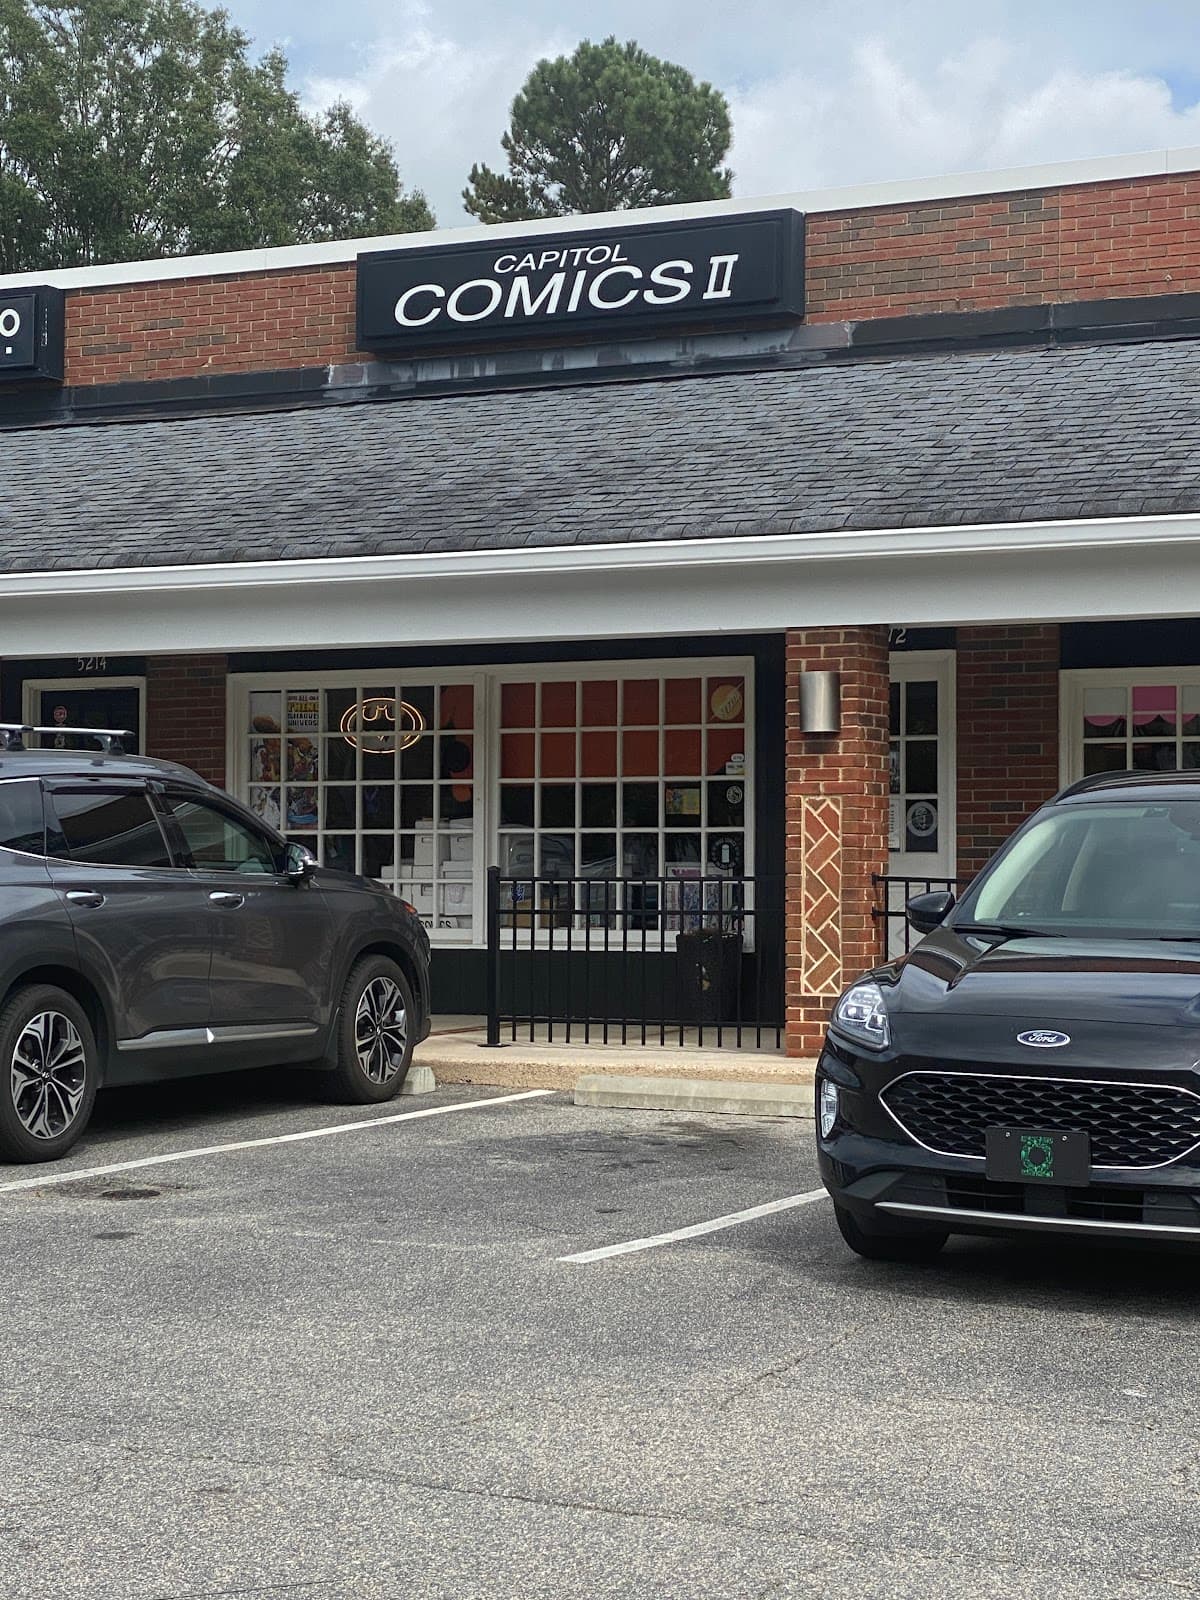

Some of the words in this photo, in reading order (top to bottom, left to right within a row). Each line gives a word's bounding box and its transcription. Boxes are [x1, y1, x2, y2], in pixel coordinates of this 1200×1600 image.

[494, 243, 628, 273] CAPITOL
[394, 259, 694, 327] COMICS
[702, 254, 738, 300] II
[77, 655, 106, 671] 5214
[1028, 1032, 1058, 1043] Ford
